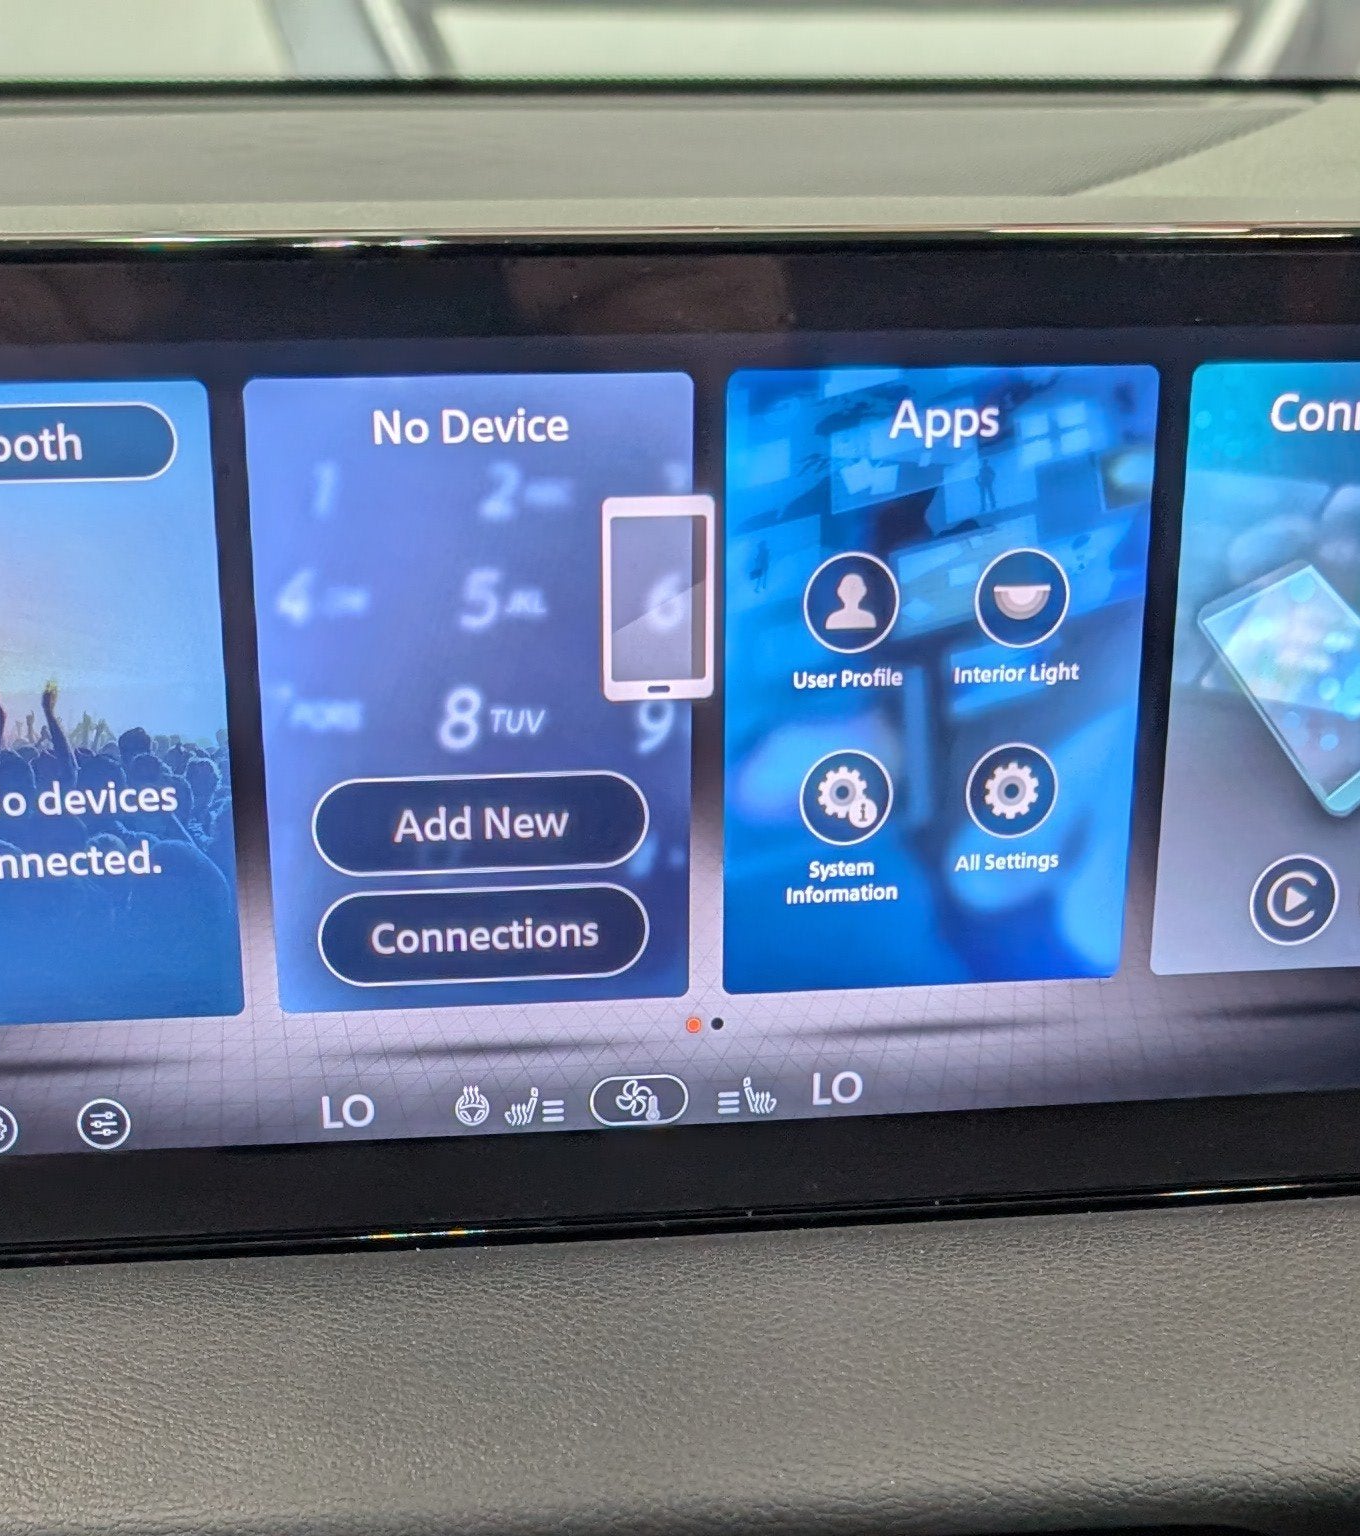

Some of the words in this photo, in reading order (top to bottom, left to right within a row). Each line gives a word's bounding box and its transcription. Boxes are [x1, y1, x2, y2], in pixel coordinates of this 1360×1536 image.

[371, 410, 430, 445] No
[441, 406, 570, 443] Device
[889, 398, 1000, 446] Apps
[460, 567, 502, 632] 5
[793, 670, 837, 690] User
[841, 666, 903, 690] Profile
[954, 665, 1026, 685] Interior
[1031, 661, 1081, 686] Light
[439, 686, 482, 751] 8
[490, 708, 546, 736] TUV
[39, 781, 179, 815] devices
[392, 805, 472, 844] Add
[484, 806, 570, 841] New
[808, 861, 875, 885] System
[955, 852, 980, 872] All
[985, 850, 1061, 875] Settings
[785, 883, 899, 905] Information
[371, 919, 600, 955] Connections
[811, 1071, 865, 1106] LO
[320, 1094, 376, 1129] LO
